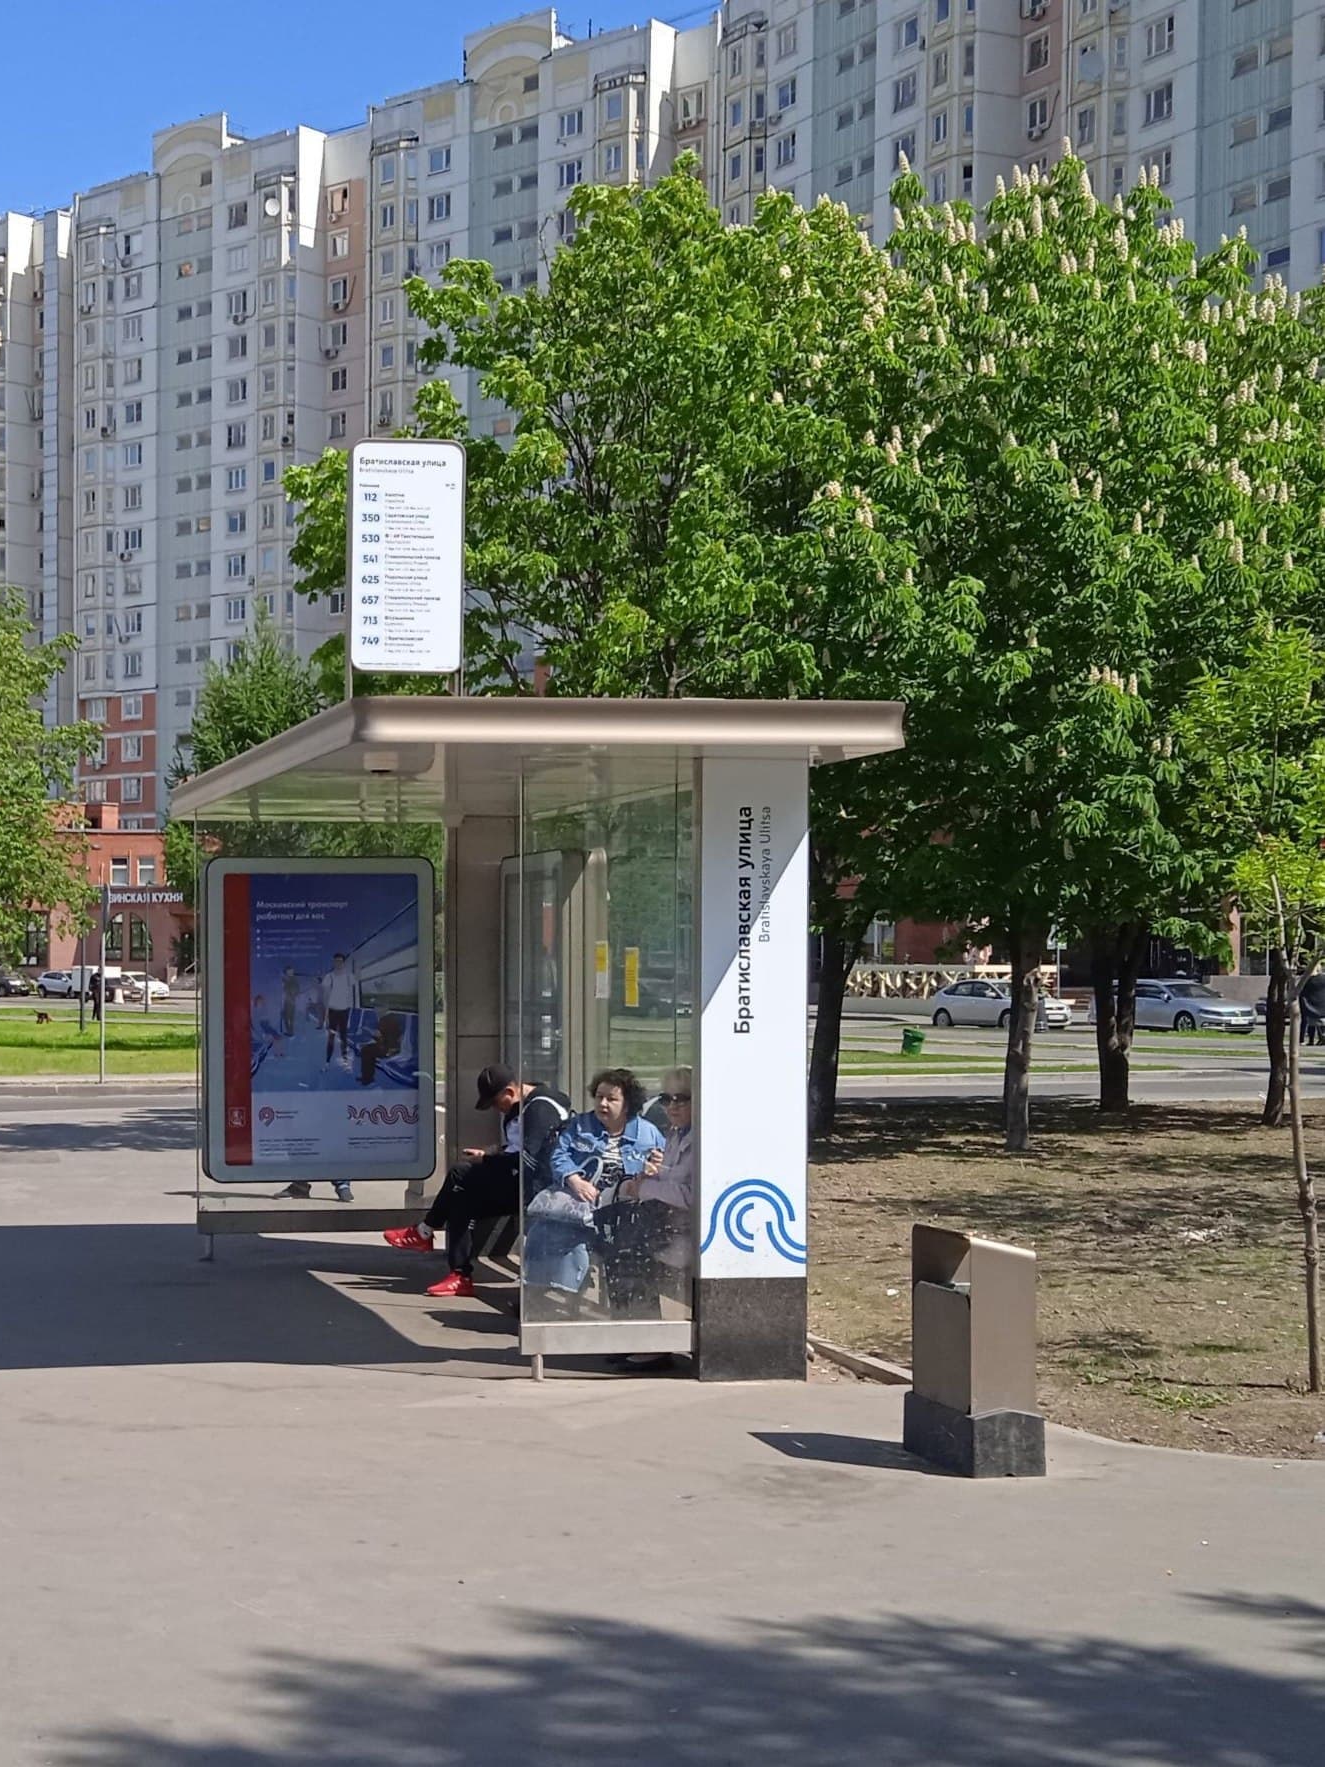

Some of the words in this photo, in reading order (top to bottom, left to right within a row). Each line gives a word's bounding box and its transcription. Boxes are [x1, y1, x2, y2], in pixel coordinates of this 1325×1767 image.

[359, 456, 420, 467] Братиславская
[421, 459, 447, 468] улица
[363, 493, 378, 502] 112
[361, 513, 380, 523] 350
[361, 534, 380, 543] 530
[363, 554, 378, 564] 541
[361, 575, 380, 585] 625
[361, 595, 379, 605] 657
[362, 616, 378, 625] 713
[361, 636, 380, 646] 749
[758, 805, 771, 843] Ulitsa
[738, 805, 755, 869] улица
[759, 846, 773, 943] Bratislavskaya
[734, 876, 754, 1034] Братиславская
